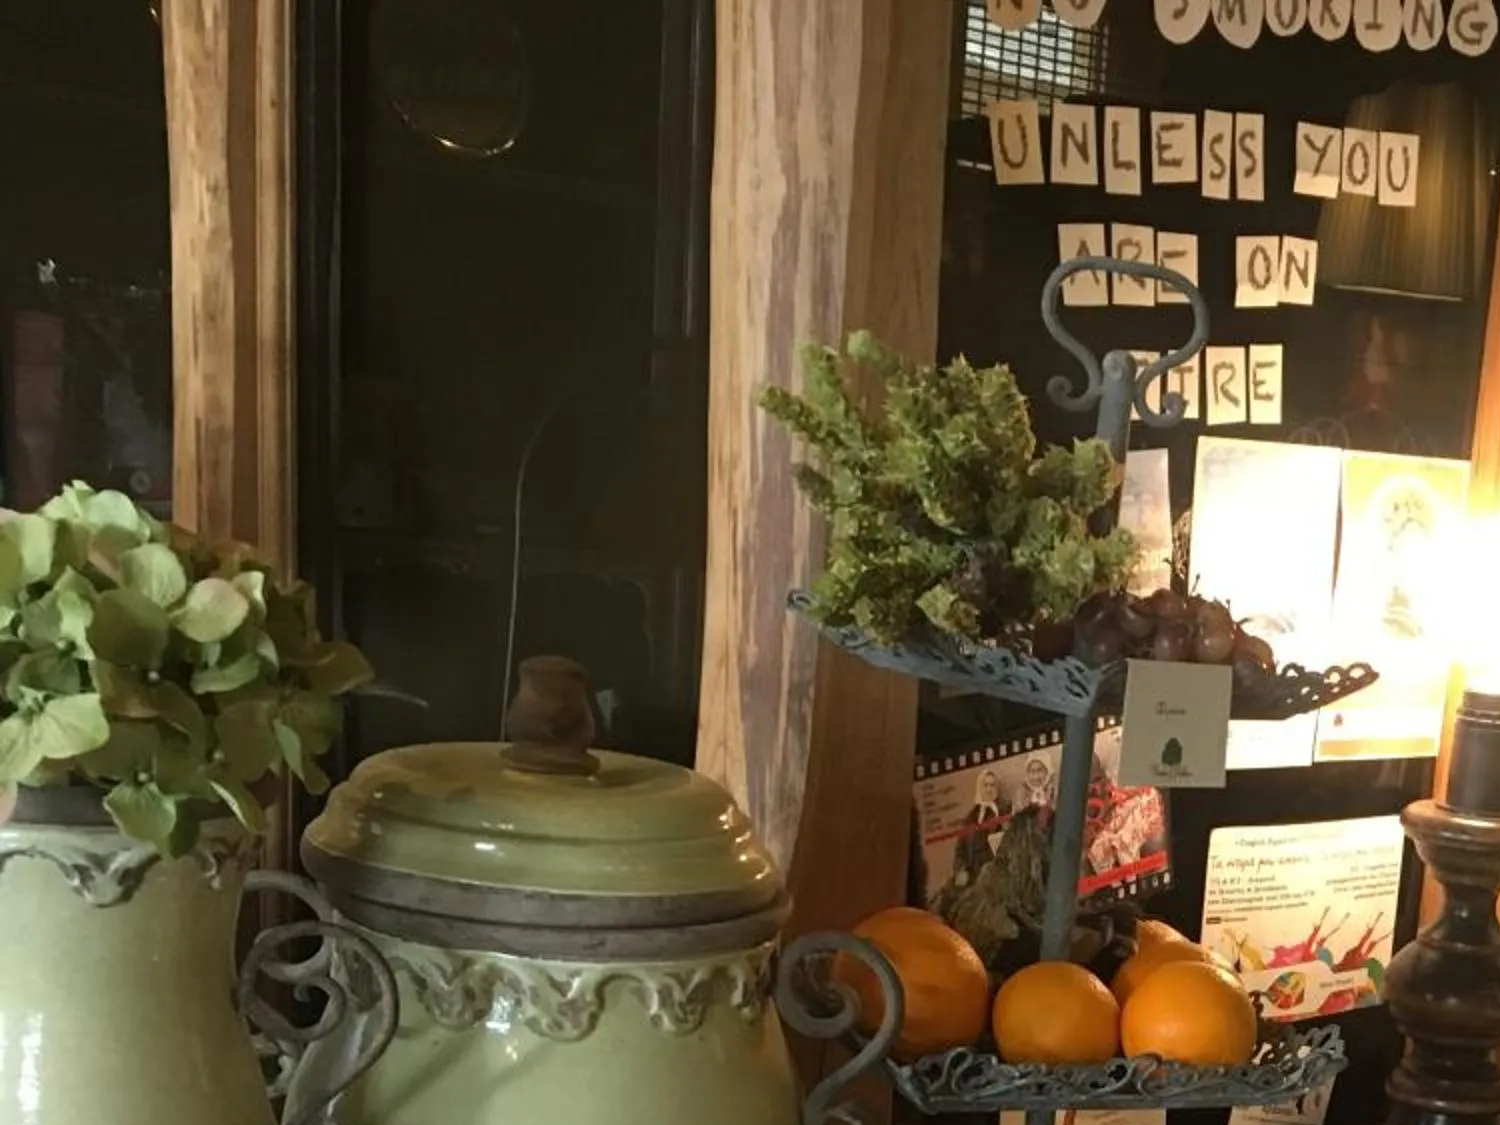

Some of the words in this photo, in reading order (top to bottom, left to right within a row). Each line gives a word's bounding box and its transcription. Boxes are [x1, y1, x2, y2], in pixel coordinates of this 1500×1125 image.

[995, 119, 1257, 182] UNLESS
[1304, 133, 1413, 193] YOU
[1069, 236, 1190, 294] ARE
[1247, 243, 1310, 292] ON
[1133, 356, 1278, 408] IRE
